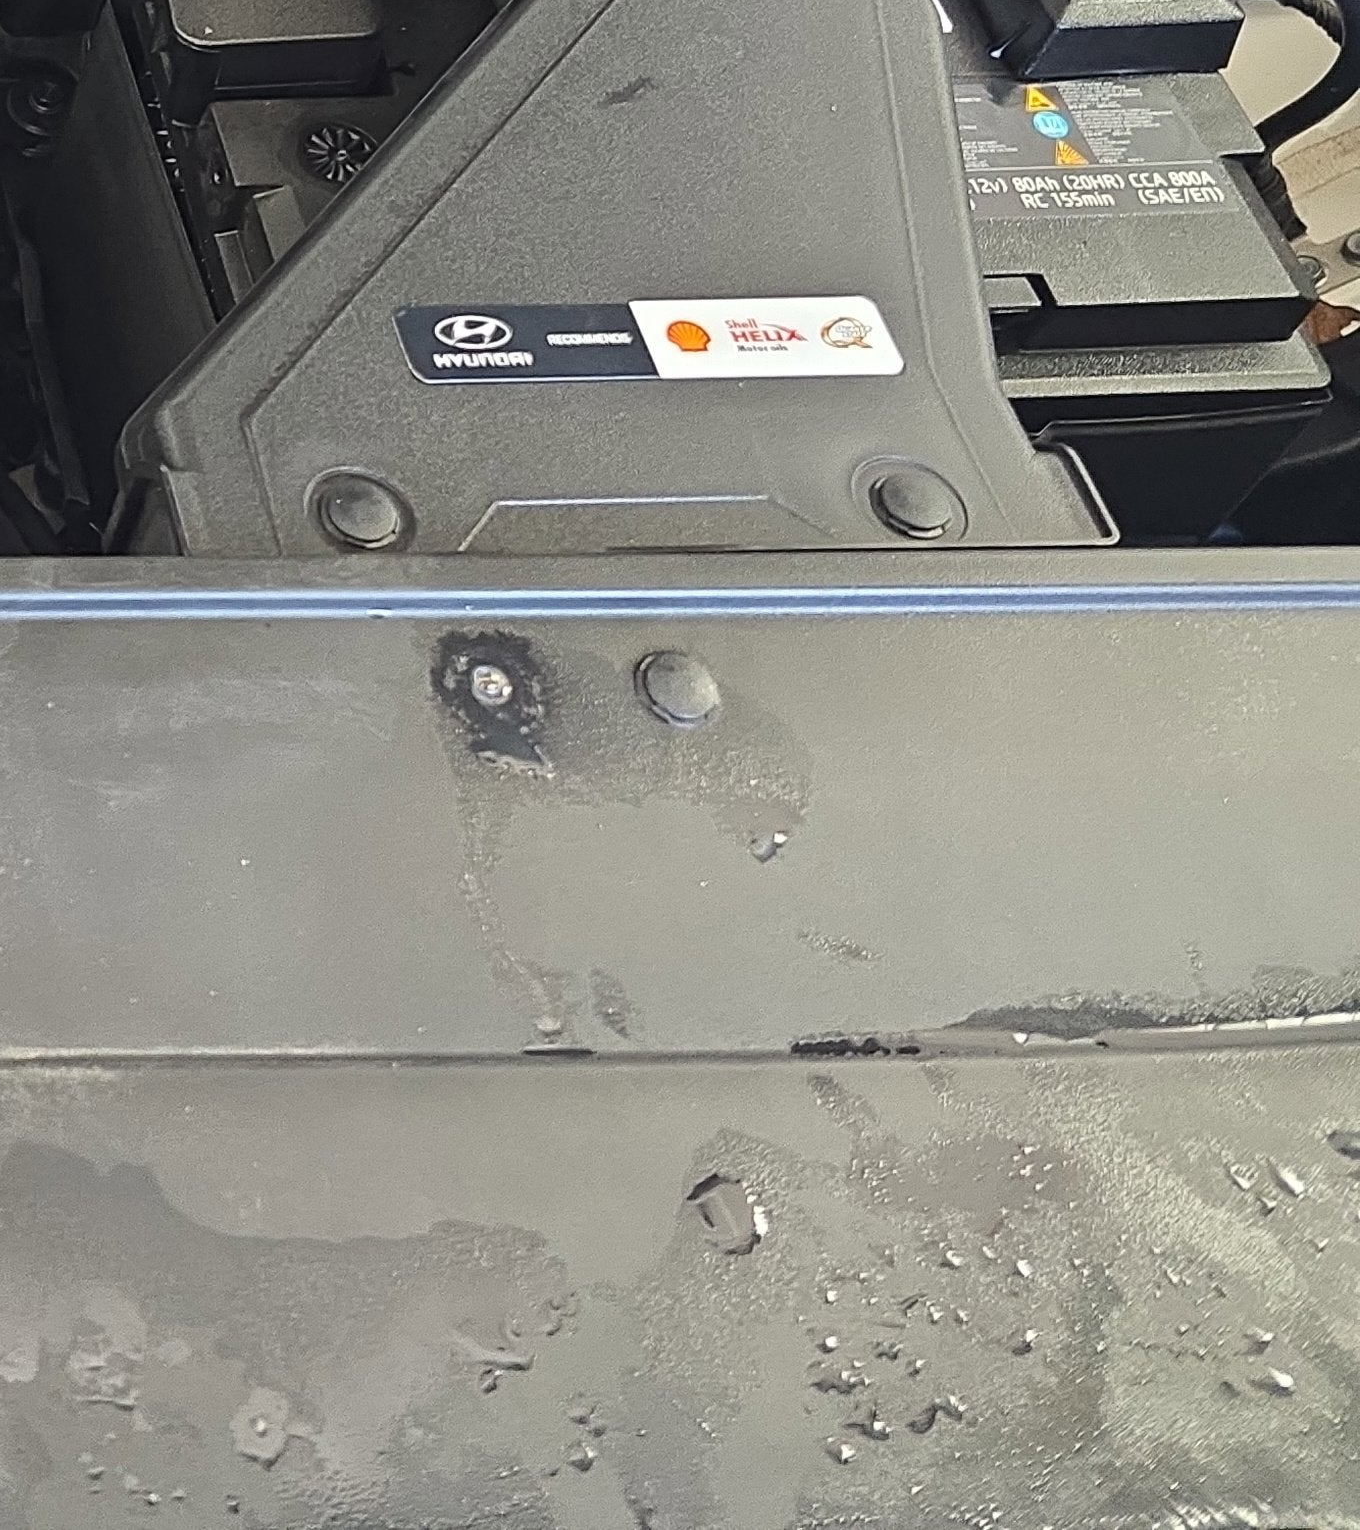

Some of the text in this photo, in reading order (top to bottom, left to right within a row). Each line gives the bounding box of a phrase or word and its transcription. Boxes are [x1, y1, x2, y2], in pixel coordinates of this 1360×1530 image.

[1011, 175, 1061, 193] 80Ah
[1062, 173, 1125, 192] (20HR)
[1129, 172, 1168, 188] CCA
[1169, 170, 1216, 187] 800A
[1020, 193, 1049, 209] RC
[1049, 191, 1116, 208] 155min
[724, 318, 758, 329] Shell
[729, 330, 807, 342] HELIX
[432, 351, 535, 369] HYUNDAI
